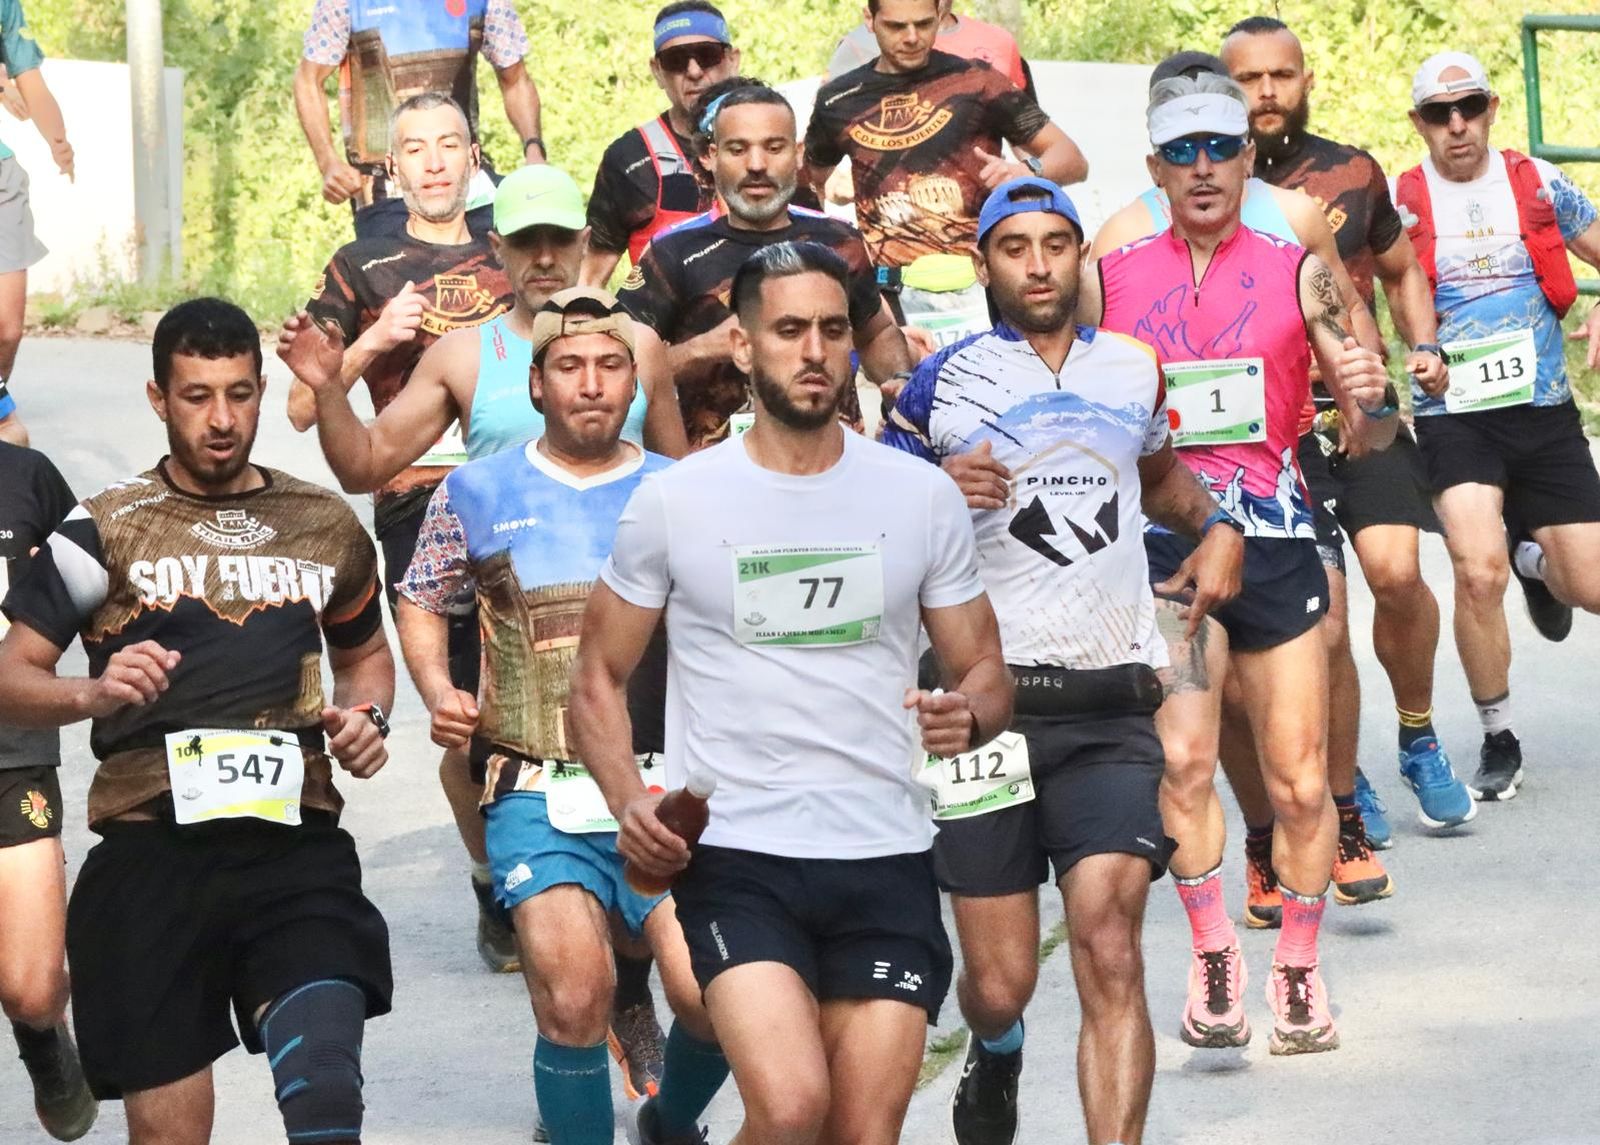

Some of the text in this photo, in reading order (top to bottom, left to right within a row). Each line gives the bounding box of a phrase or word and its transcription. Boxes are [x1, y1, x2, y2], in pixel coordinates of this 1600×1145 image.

[881, 139, 904, 147] LOS
[905, 112, 948, 145] FUERTES
[1478, 356, 1525, 384] 113
[1209, 388, 1226, 413] 1
[1026, 475, 1107, 486] PINCHO
[128, 555, 209, 606] SOY
[740, 561, 770, 575] 21K
[798, 576, 844, 610] 77
[216, 753, 285, 787] 547
[950, 751, 1007, 785] 112
